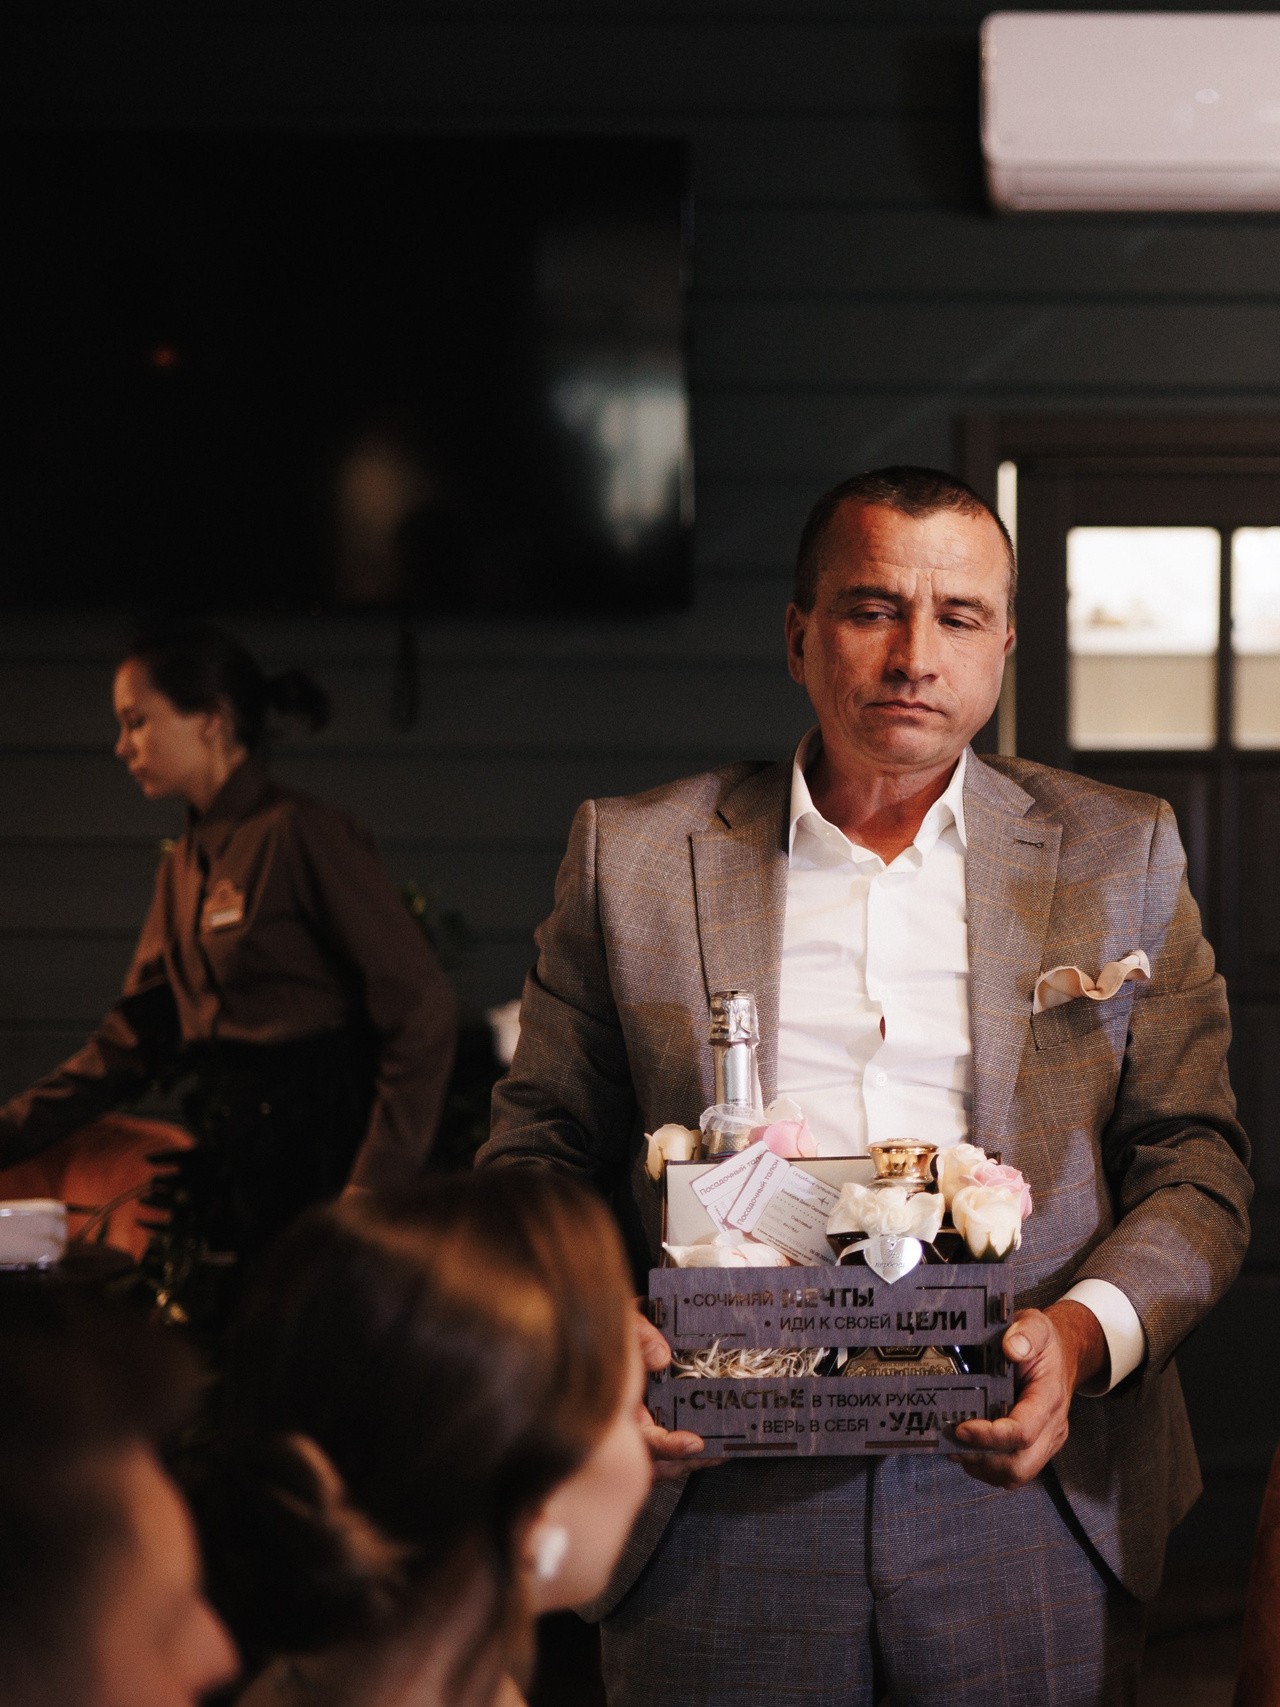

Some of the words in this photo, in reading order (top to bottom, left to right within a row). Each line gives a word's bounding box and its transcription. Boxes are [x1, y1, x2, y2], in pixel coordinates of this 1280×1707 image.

[699, 1164, 747, 1196] Посадочный
[736, 1180, 767, 1226] Посадочный
[764, 1158, 781, 1182] талон
[693, 1290, 774, 1308] СОЧИНЯЙ
[781, 1287, 875, 1308] МЕЧТЫ
[780, 1316, 815, 1332] ИДИ
[820, 1316, 831, 1331] К
[834, 1313, 891, 1331] СВОЕЙ
[896, 1310, 968, 1335] ЦЕЛИ
[689, 1388, 805, 1410] СЧАСТЬЕ
[812, 1395, 822, 1408] В
[826, 1394, 882, 1408] ТВОИХ
[886, 1392, 938, 1407] РУКАХ
[763, 1419, 805, 1434] ВЕРЬ
[810, 1418, 820, 1433] В
[824, 1417, 869, 1433] СЕБЯ
